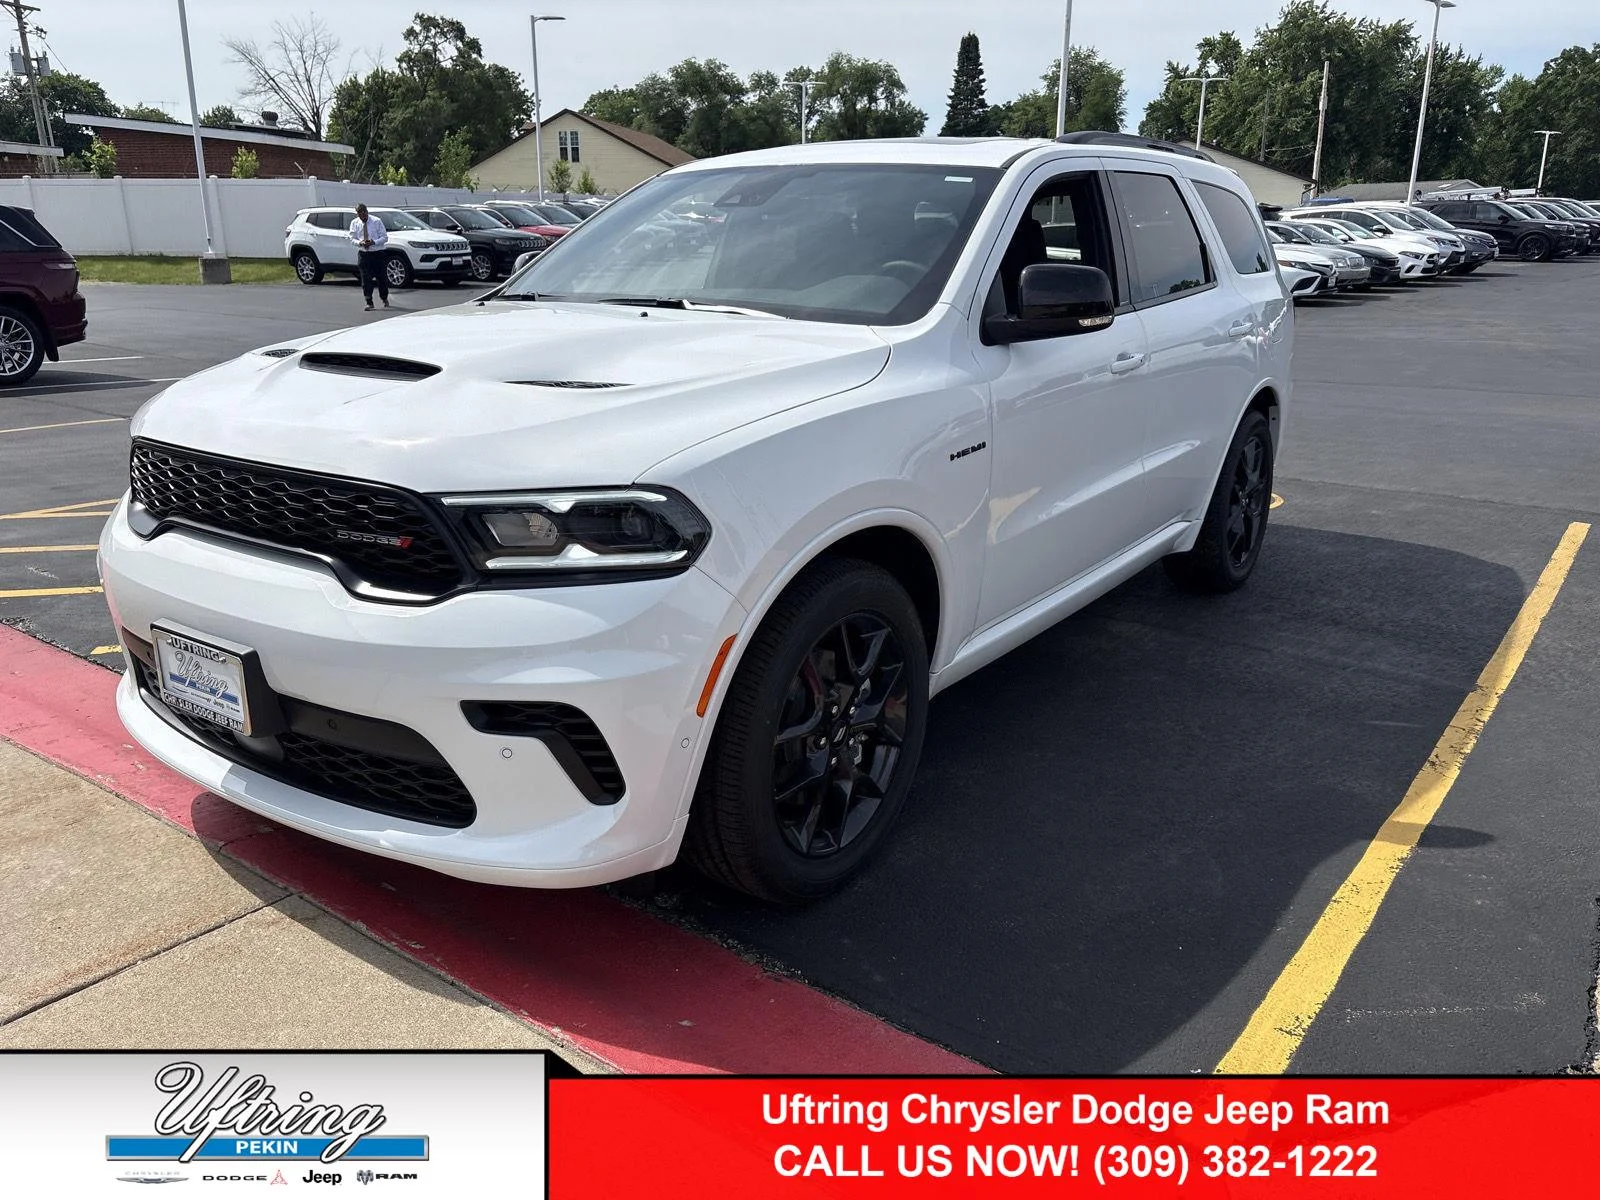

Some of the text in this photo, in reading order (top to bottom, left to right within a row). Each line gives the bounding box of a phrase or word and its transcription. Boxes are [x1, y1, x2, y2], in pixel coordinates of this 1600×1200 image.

[950, 441, 986, 461] HEMI
[337, 531, 402, 546] DODGE
[171, 637, 220, 662] UFTRING
[194, 704, 215, 720] DODGE
[229, 719, 244, 732] RAM
